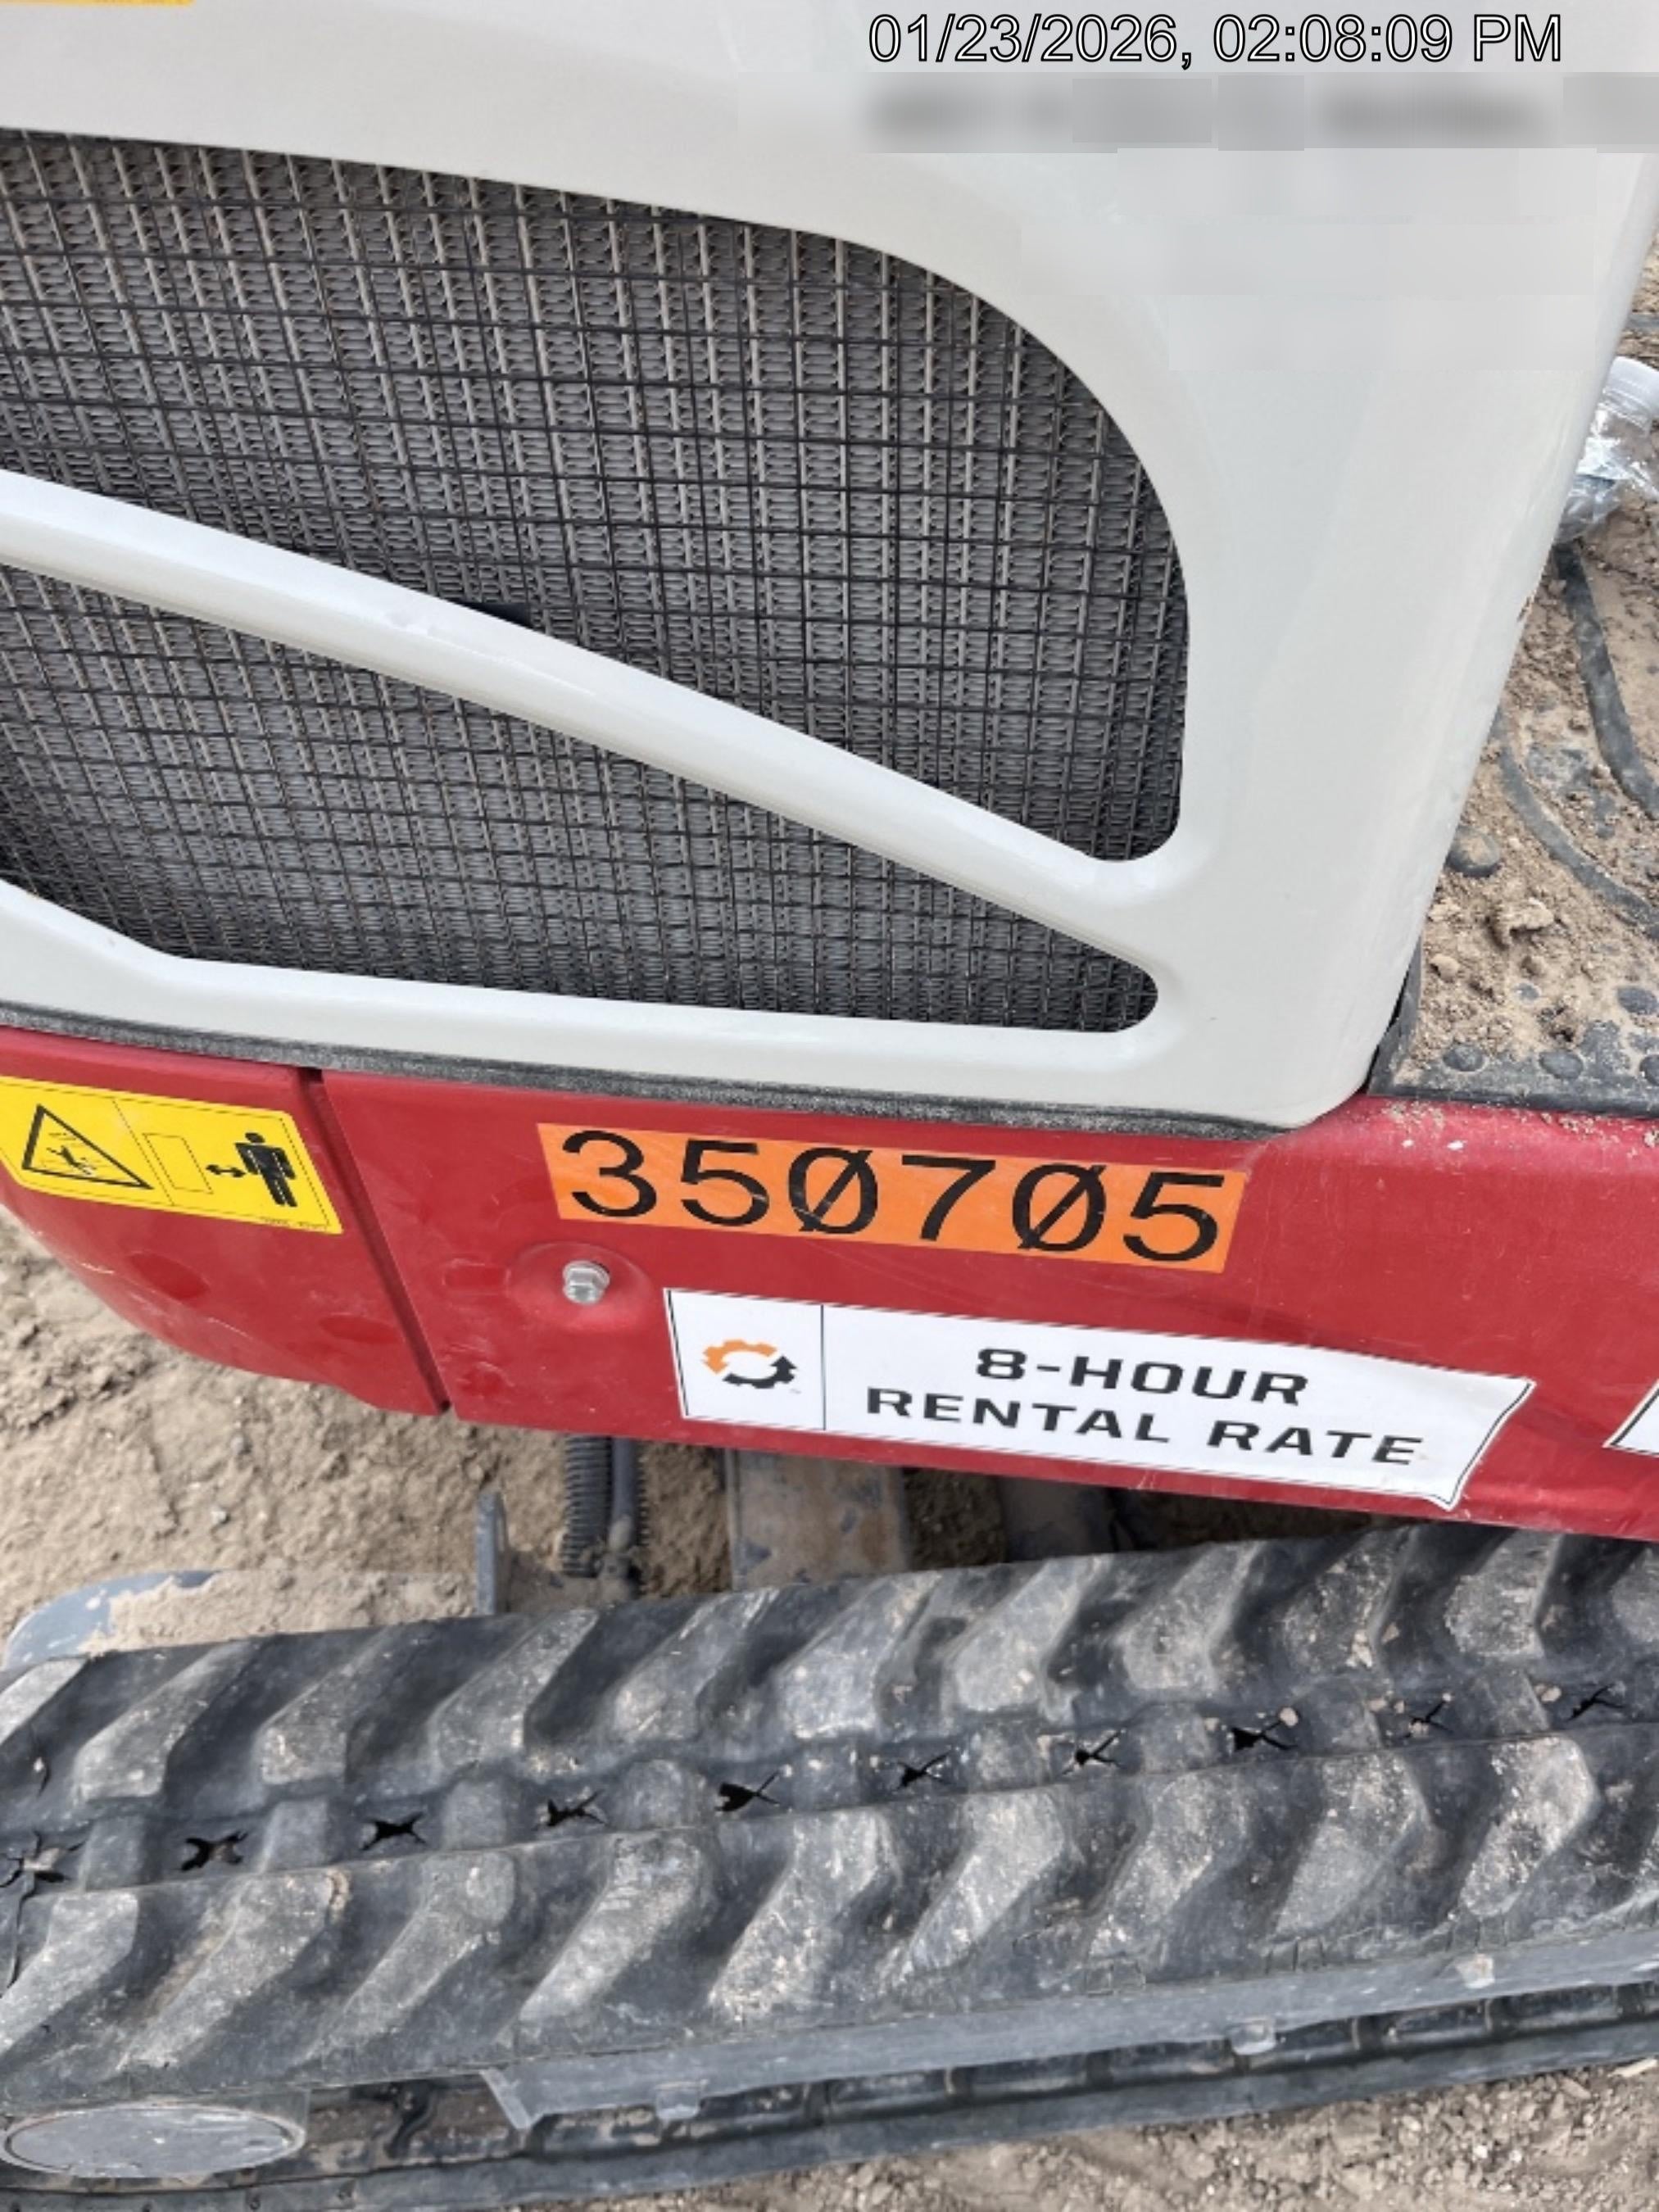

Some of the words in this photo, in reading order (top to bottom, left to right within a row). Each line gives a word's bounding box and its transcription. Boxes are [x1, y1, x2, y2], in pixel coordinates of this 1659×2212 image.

[560, 1130, 1227, 1262] 350705
[975, 1348, 1308, 1406] 8-HOUR
[866, 1387, 1171, 1444] RENTAL
[1207, 1420, 1423, 1466] RATE
